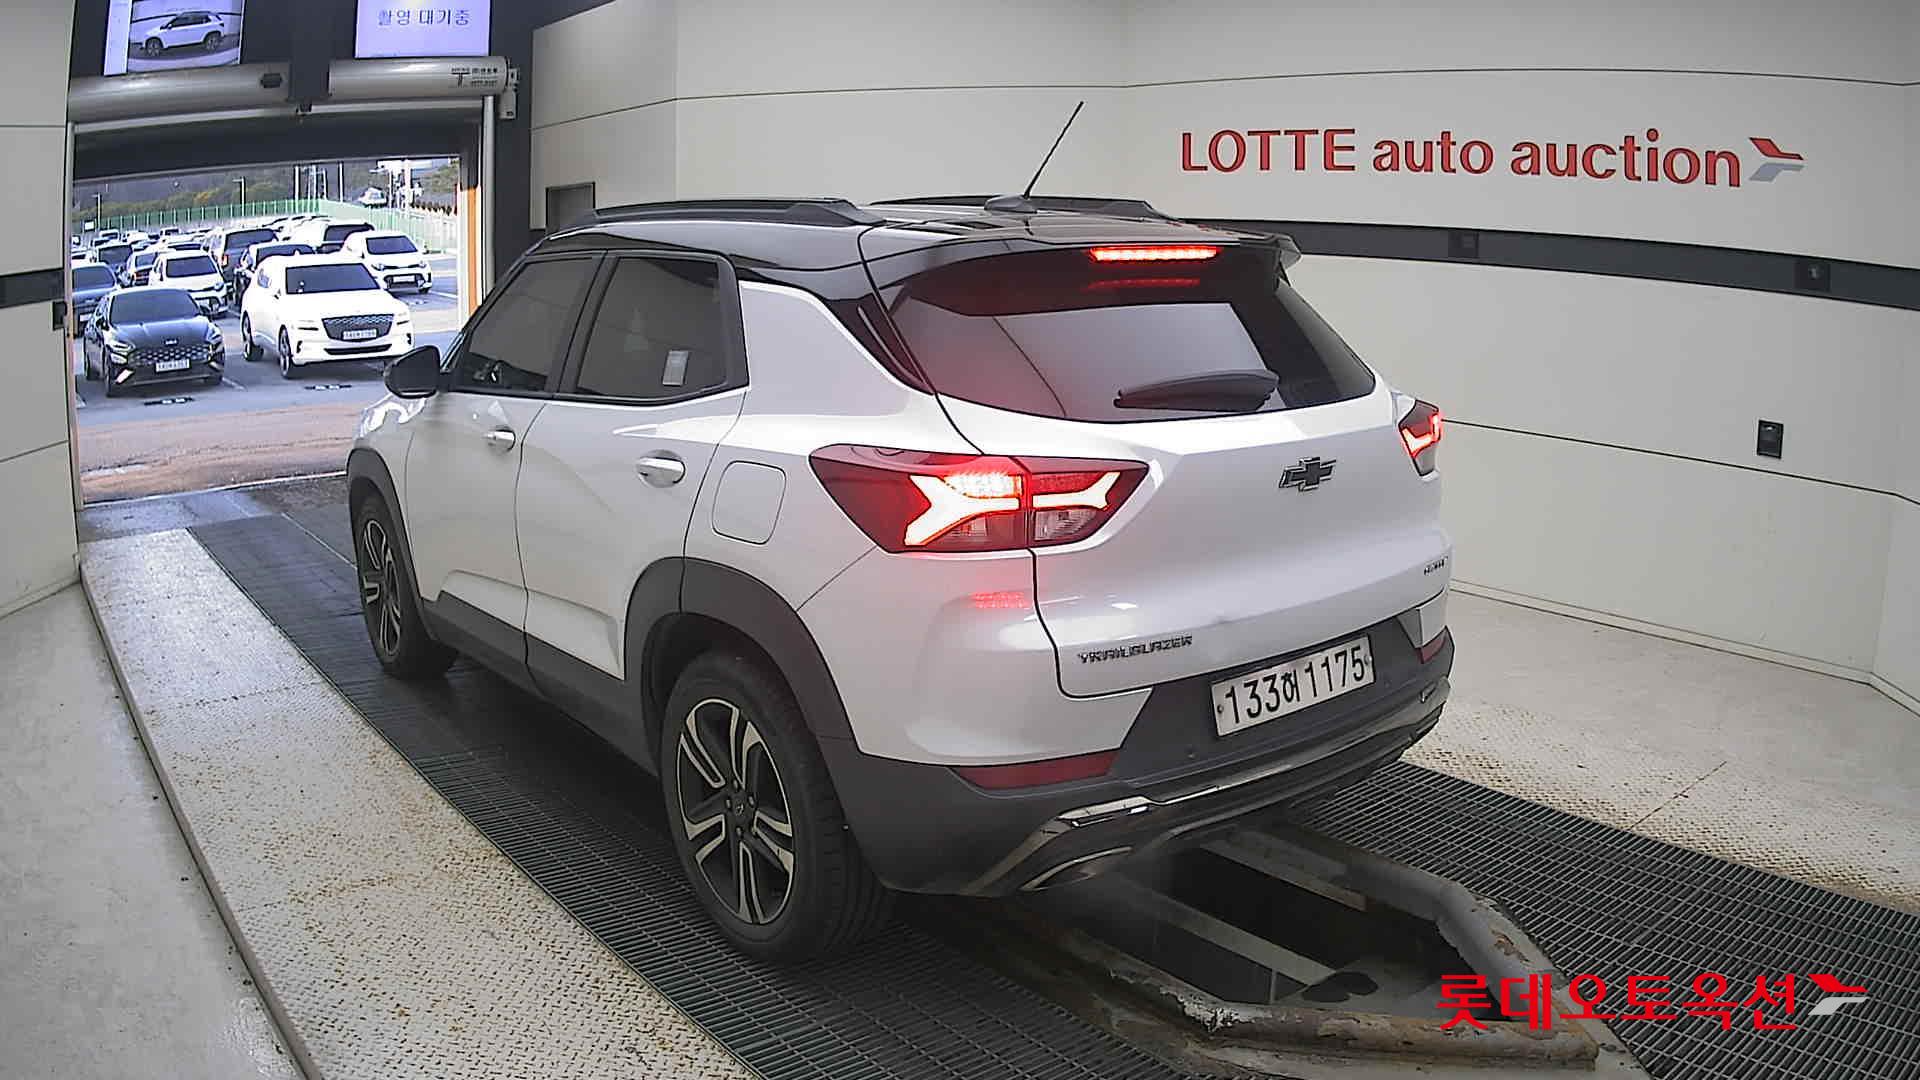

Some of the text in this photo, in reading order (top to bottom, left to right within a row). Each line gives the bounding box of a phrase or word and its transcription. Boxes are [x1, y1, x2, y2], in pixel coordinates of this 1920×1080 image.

[419, 8, 470, 26] 대기중
[1182, 128, 1741, 188] LOTTE auto auction
